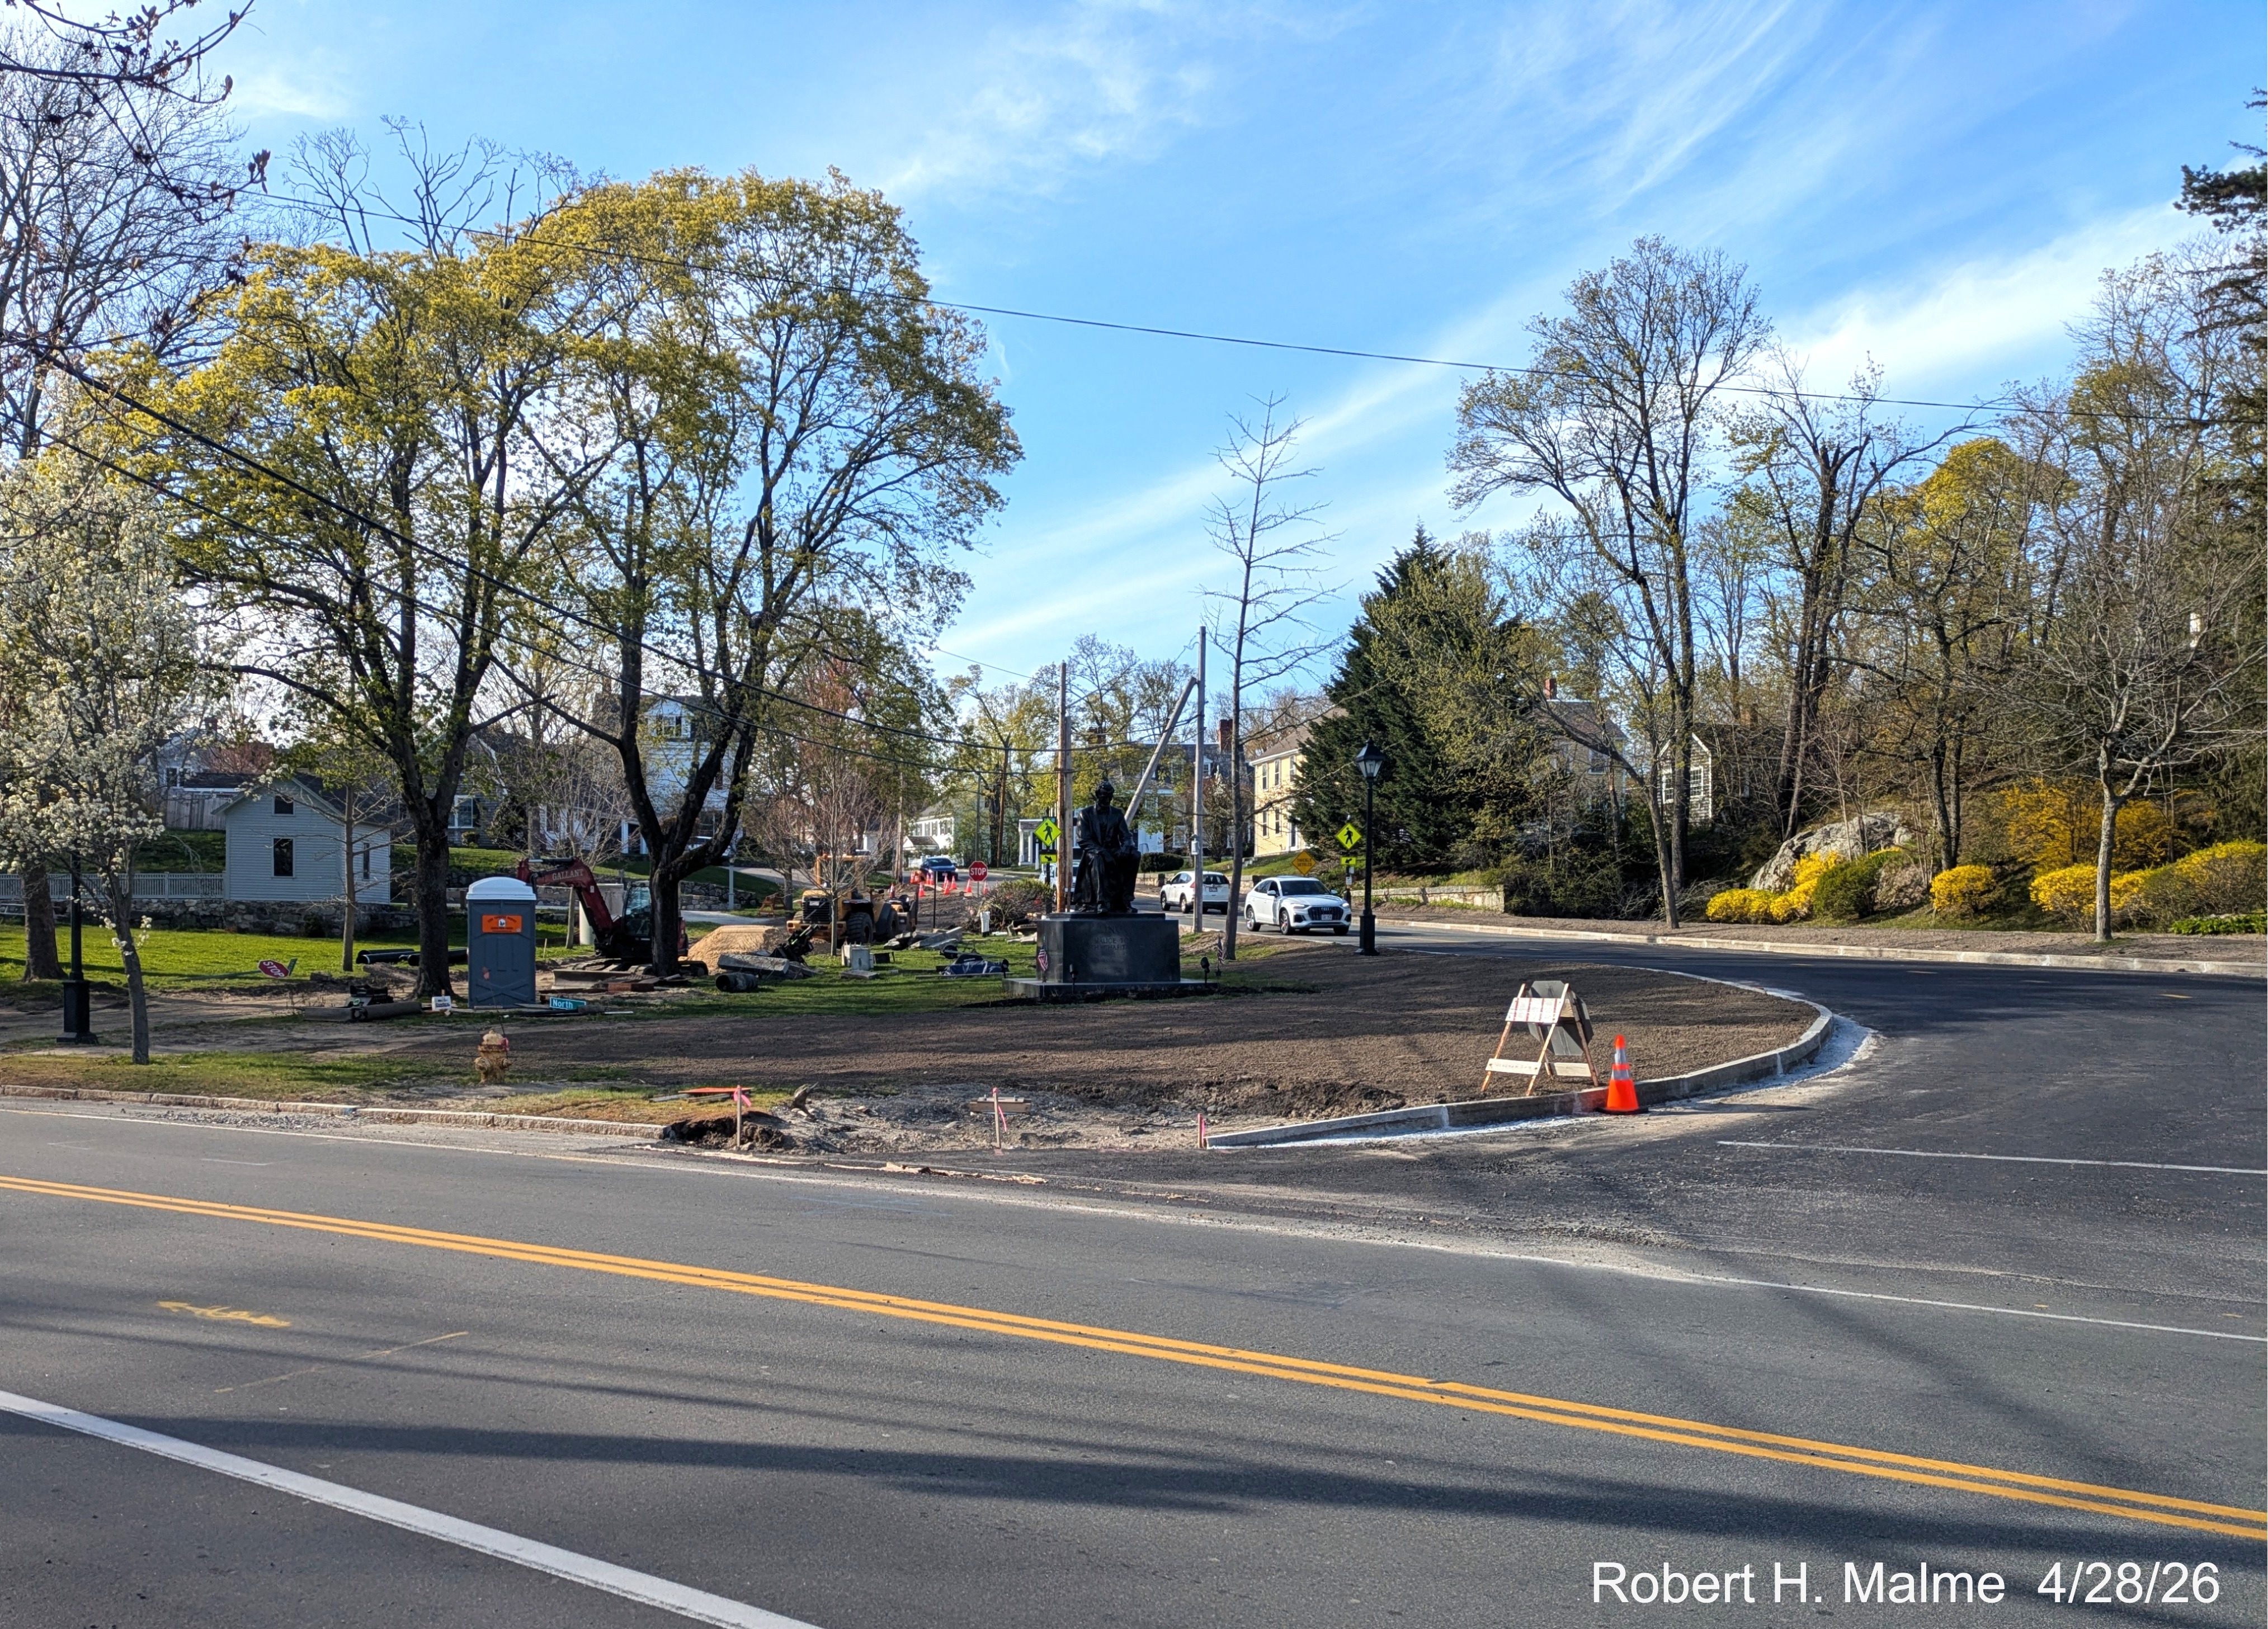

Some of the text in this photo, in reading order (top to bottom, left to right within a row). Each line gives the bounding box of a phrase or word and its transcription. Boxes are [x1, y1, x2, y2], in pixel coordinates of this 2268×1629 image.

[552, 868, 583, 881] GALLANT
[970, 867, 987, 876] STOP
[263, 961, 285, 977] STOP
[553, 999, 573, 1009] North
